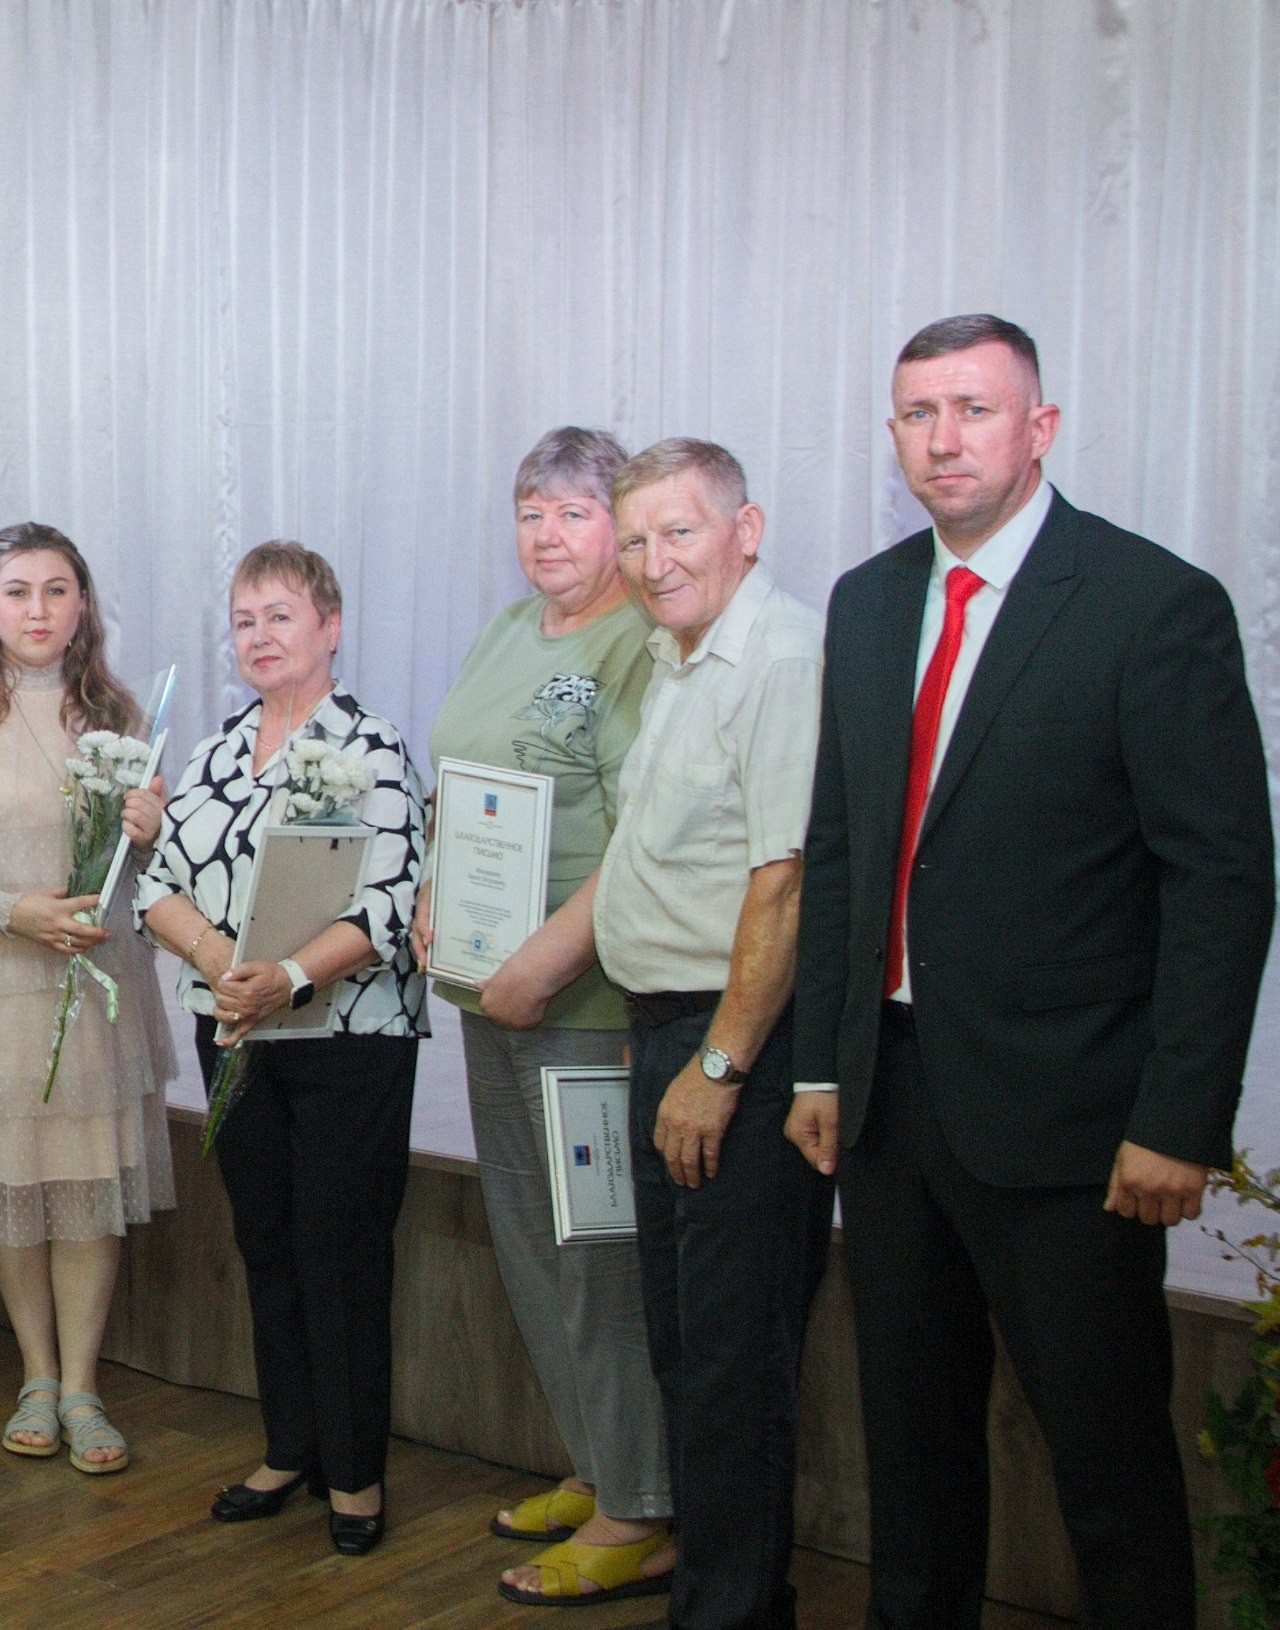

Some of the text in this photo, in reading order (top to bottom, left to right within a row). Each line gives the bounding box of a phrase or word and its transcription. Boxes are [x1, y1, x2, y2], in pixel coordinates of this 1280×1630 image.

[473, 846, 504, 861] ПИСЬМО
[599, 1100, 618, 1208] БЛАГОДАРСТВЕННОЕ
[612, 1129, 625, 1177] ПИСЬМО
